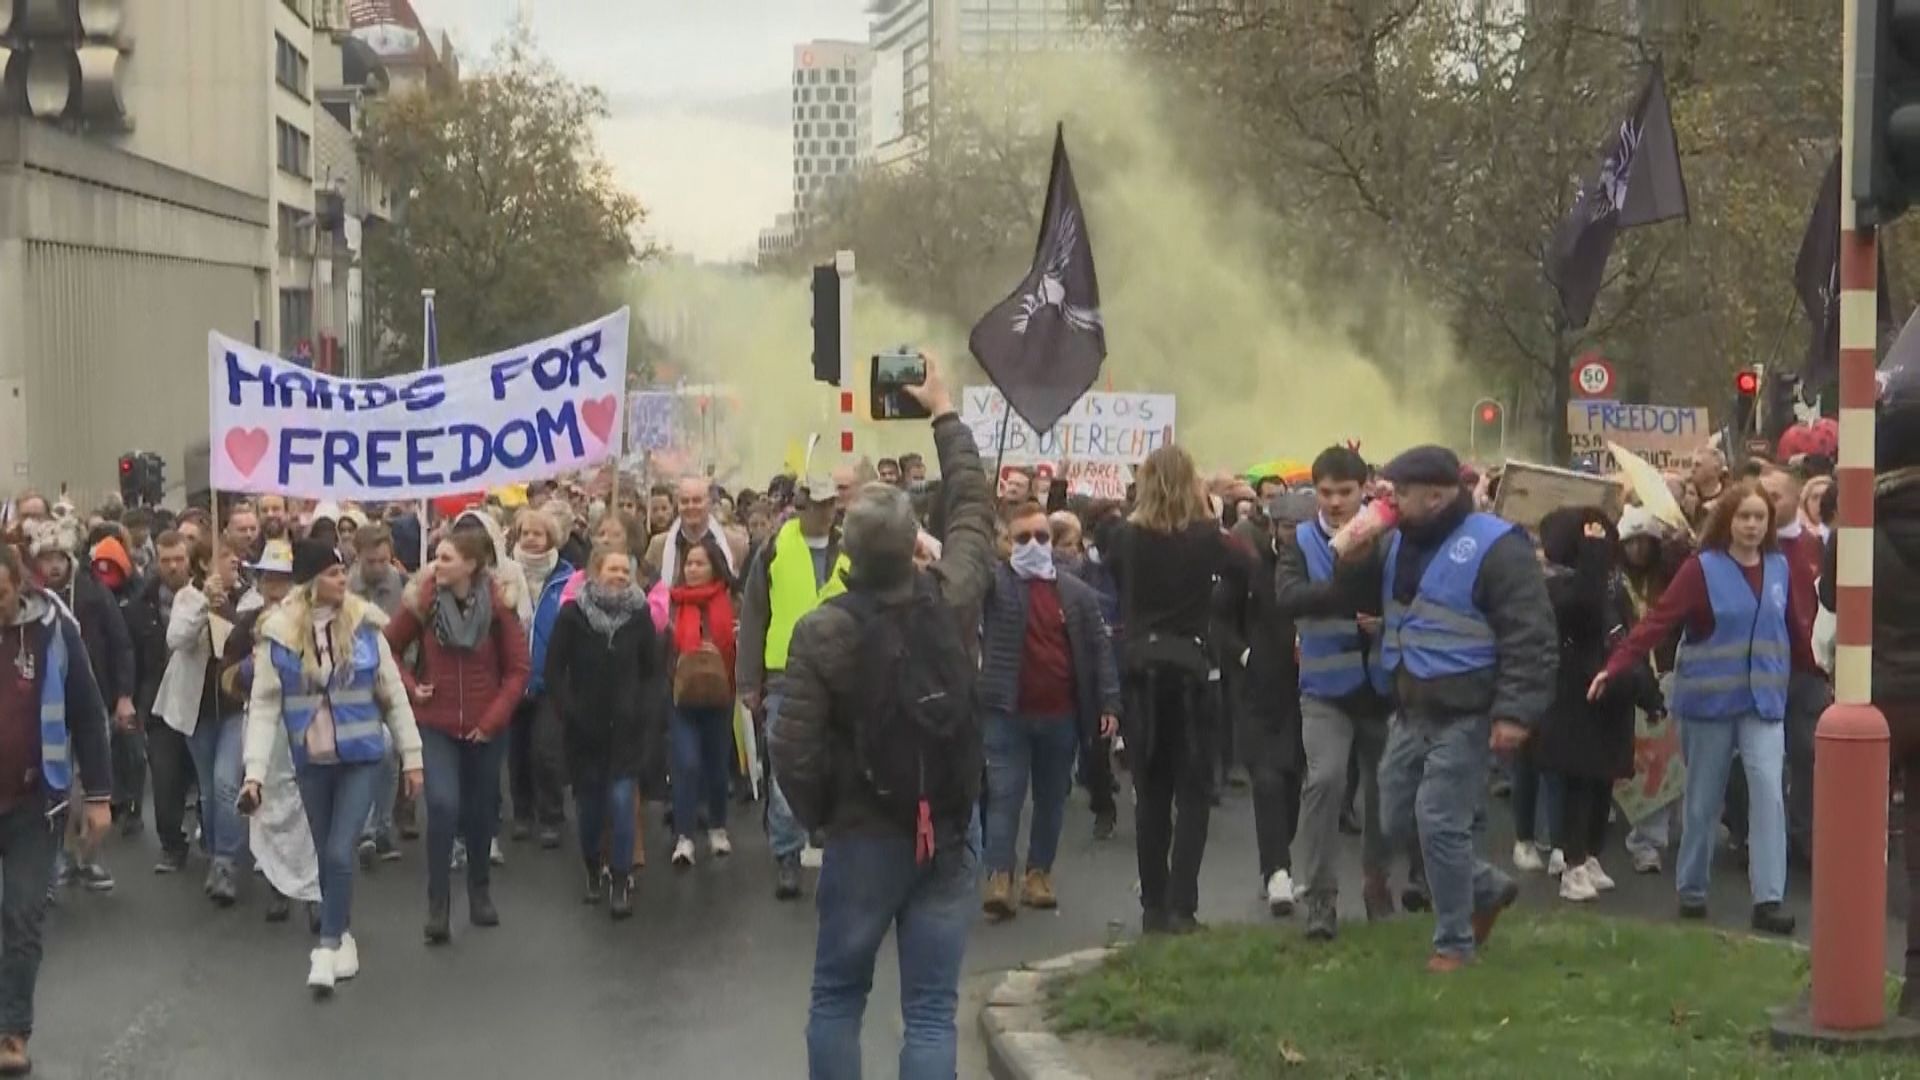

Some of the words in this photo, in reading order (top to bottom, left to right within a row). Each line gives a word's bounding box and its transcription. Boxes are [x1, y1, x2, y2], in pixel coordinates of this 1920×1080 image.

[226, 351, 446, 411] HANDS
[490, 330, 606, 400] FOR
[1584, 368, 1604, 383] 50
[278, 400, 584, 487] FREEDOM
[1587, 405, 1696, 435] FREEDOM
